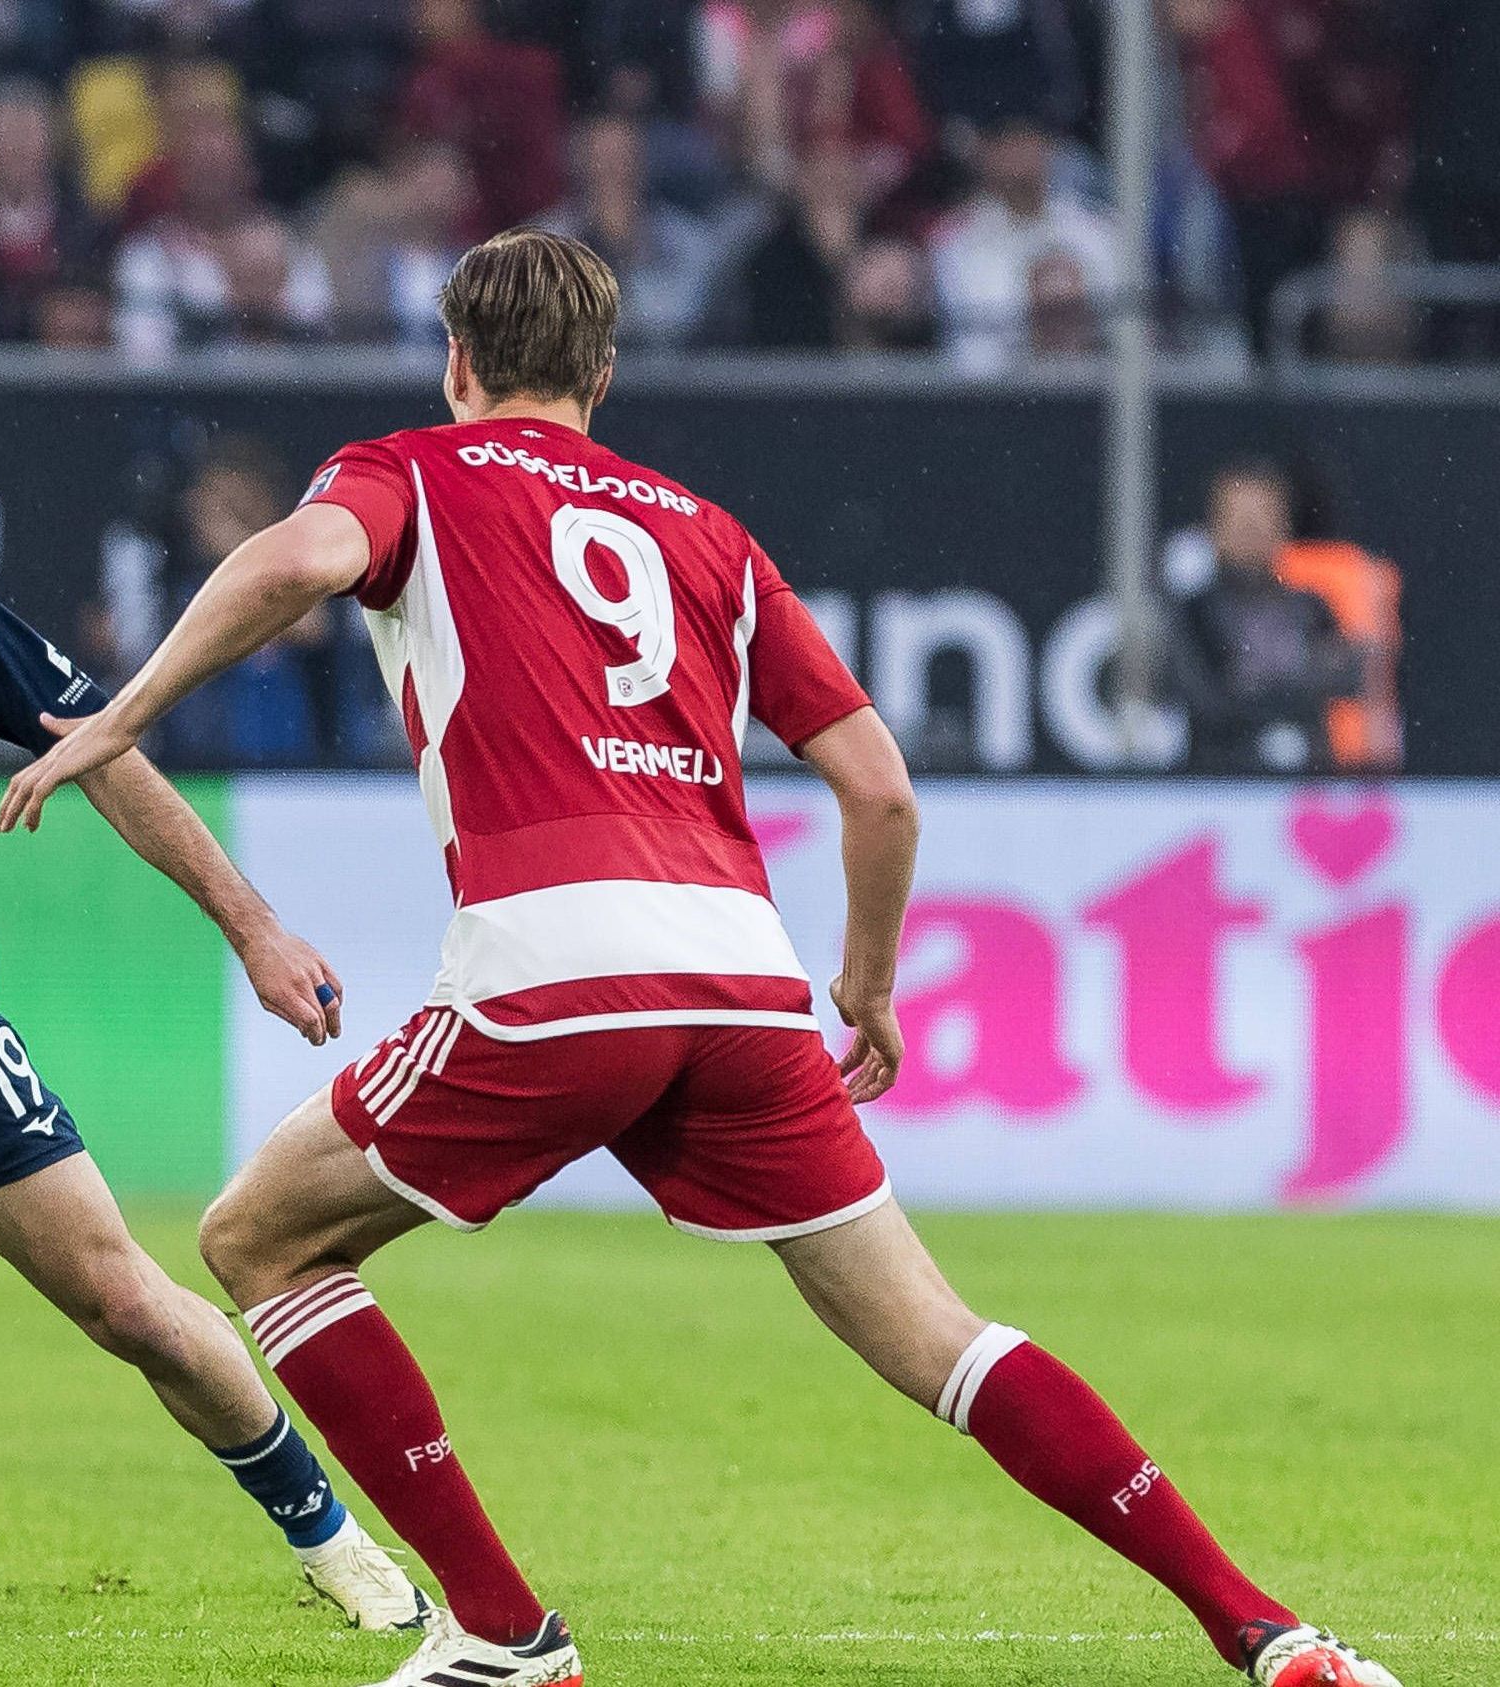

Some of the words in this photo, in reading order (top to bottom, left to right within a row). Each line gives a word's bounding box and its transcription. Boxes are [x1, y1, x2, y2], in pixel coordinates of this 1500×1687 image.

[457, 441, 699, 517] DÜSSELDORF
[550, 503, 678, 708] 9
[580, 735, 724, 787] VERMEIJ
[404, 1432, 453, 1473] F95
[1111, 1458, 1162, 1516] F95
